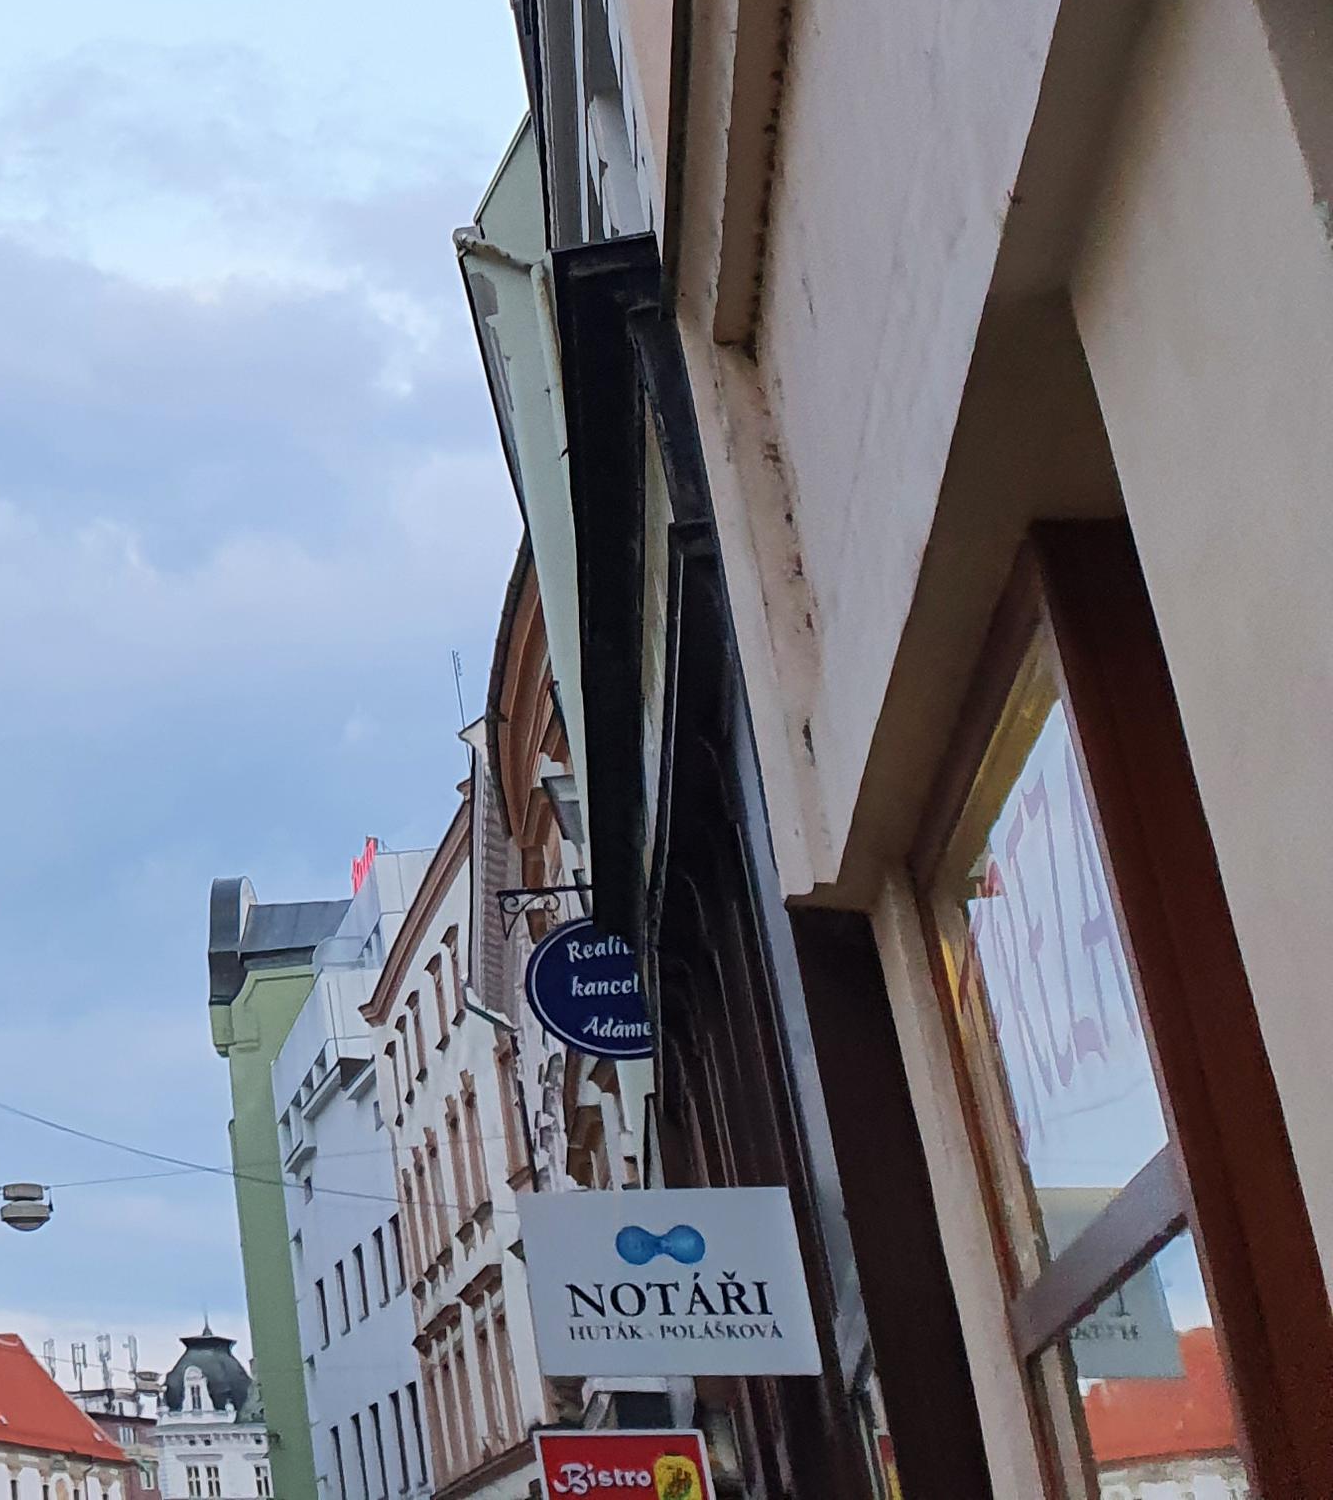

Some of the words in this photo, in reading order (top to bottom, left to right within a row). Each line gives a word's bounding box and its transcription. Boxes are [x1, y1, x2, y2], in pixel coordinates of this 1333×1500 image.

[571, 972, 639, 997] kancel
[582, 1015, 653, 1038] Adáme
[564, 1270, 774, 1317] NOTÁŘI
[568, 1321, 644, 1341] HUTÁK
[659, 1320, 784, 1340] POLÁŠKOVÁ
[552, 1463, 652, 1495] Bistro
